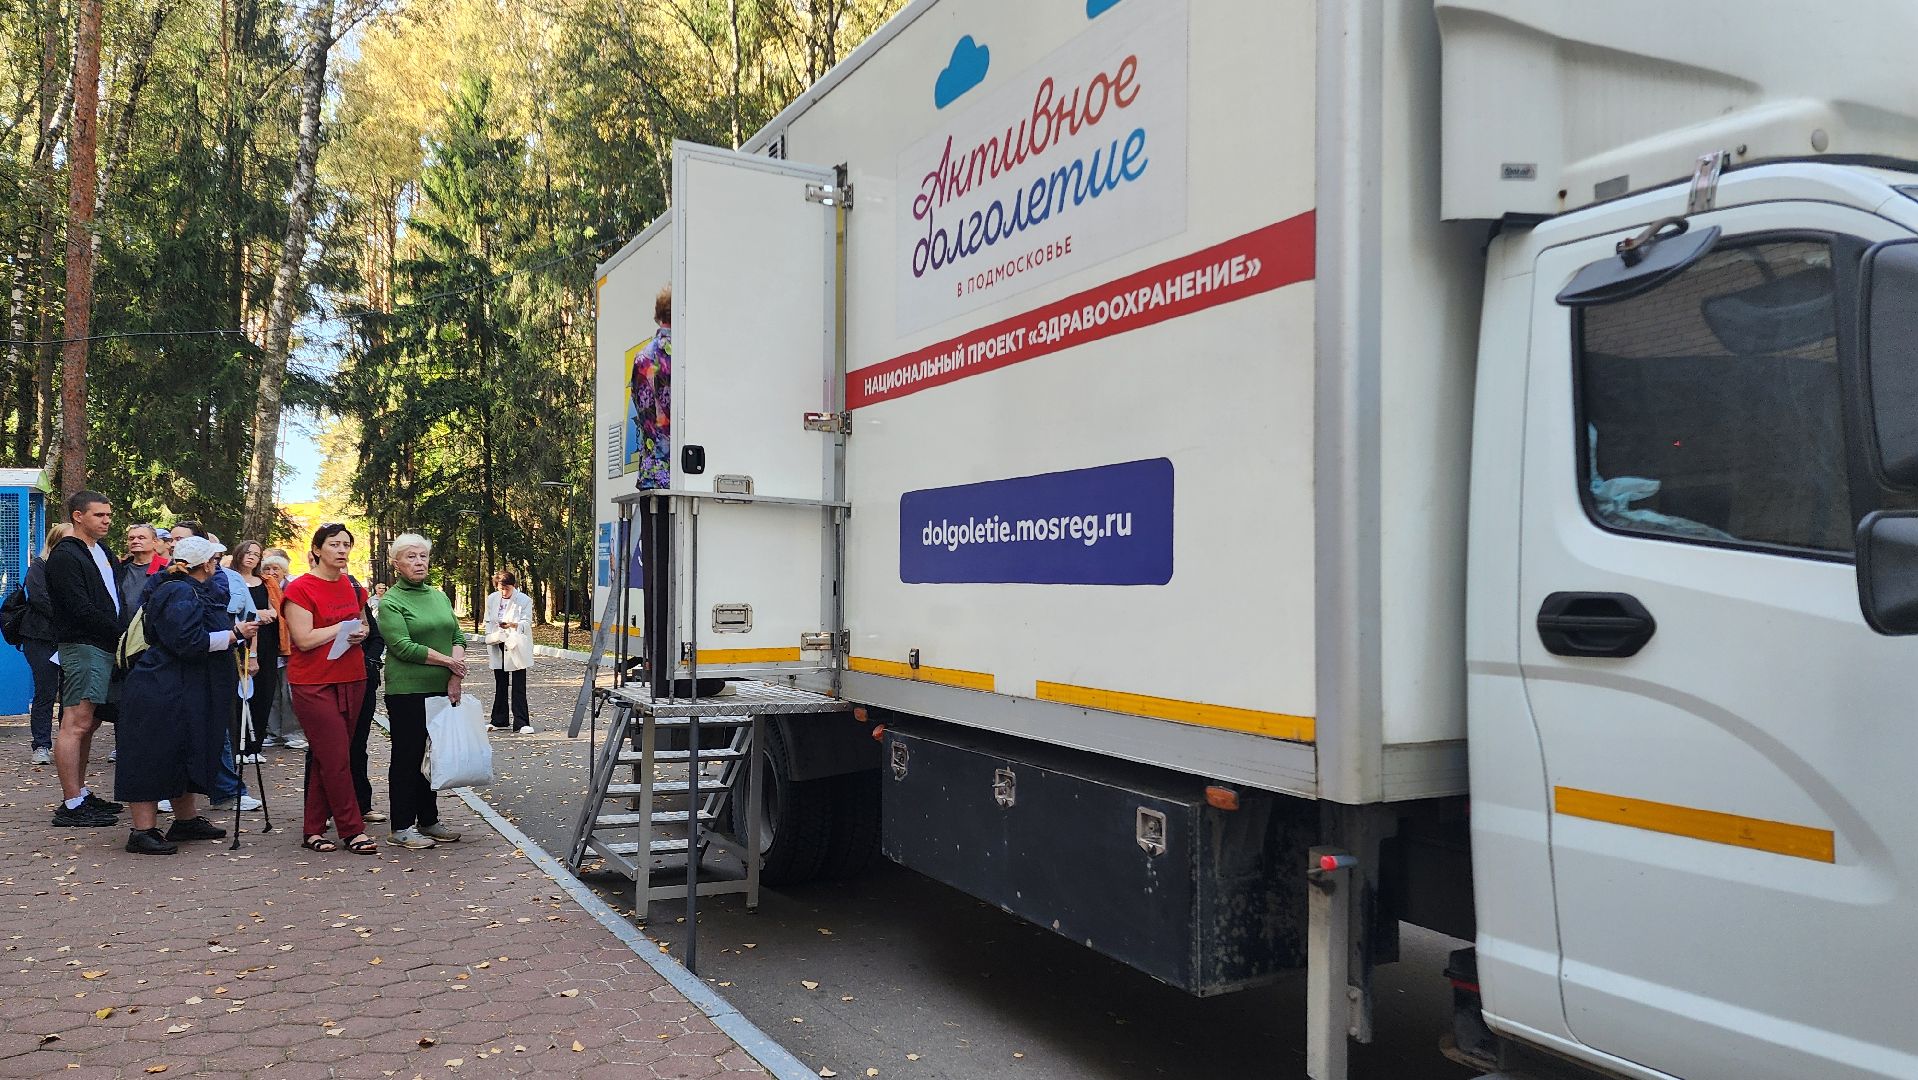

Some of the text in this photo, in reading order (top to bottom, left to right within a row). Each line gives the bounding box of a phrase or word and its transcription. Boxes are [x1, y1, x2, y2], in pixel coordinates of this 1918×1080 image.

[912, 54, 1141, 221] Активное
[912, 127, 1149, 278] долголетие
[863, 253, 1262, 397] НАЦИОНАЛЬНЫЙ ПРОЕКТ «ЗДРАВООХРАНЕНИЕ»
[967, 235, 1072, 294] ПОДМОСКОВЬЕ
[921, 512, 1132, 552] dolgoletie.mosreg.ru
